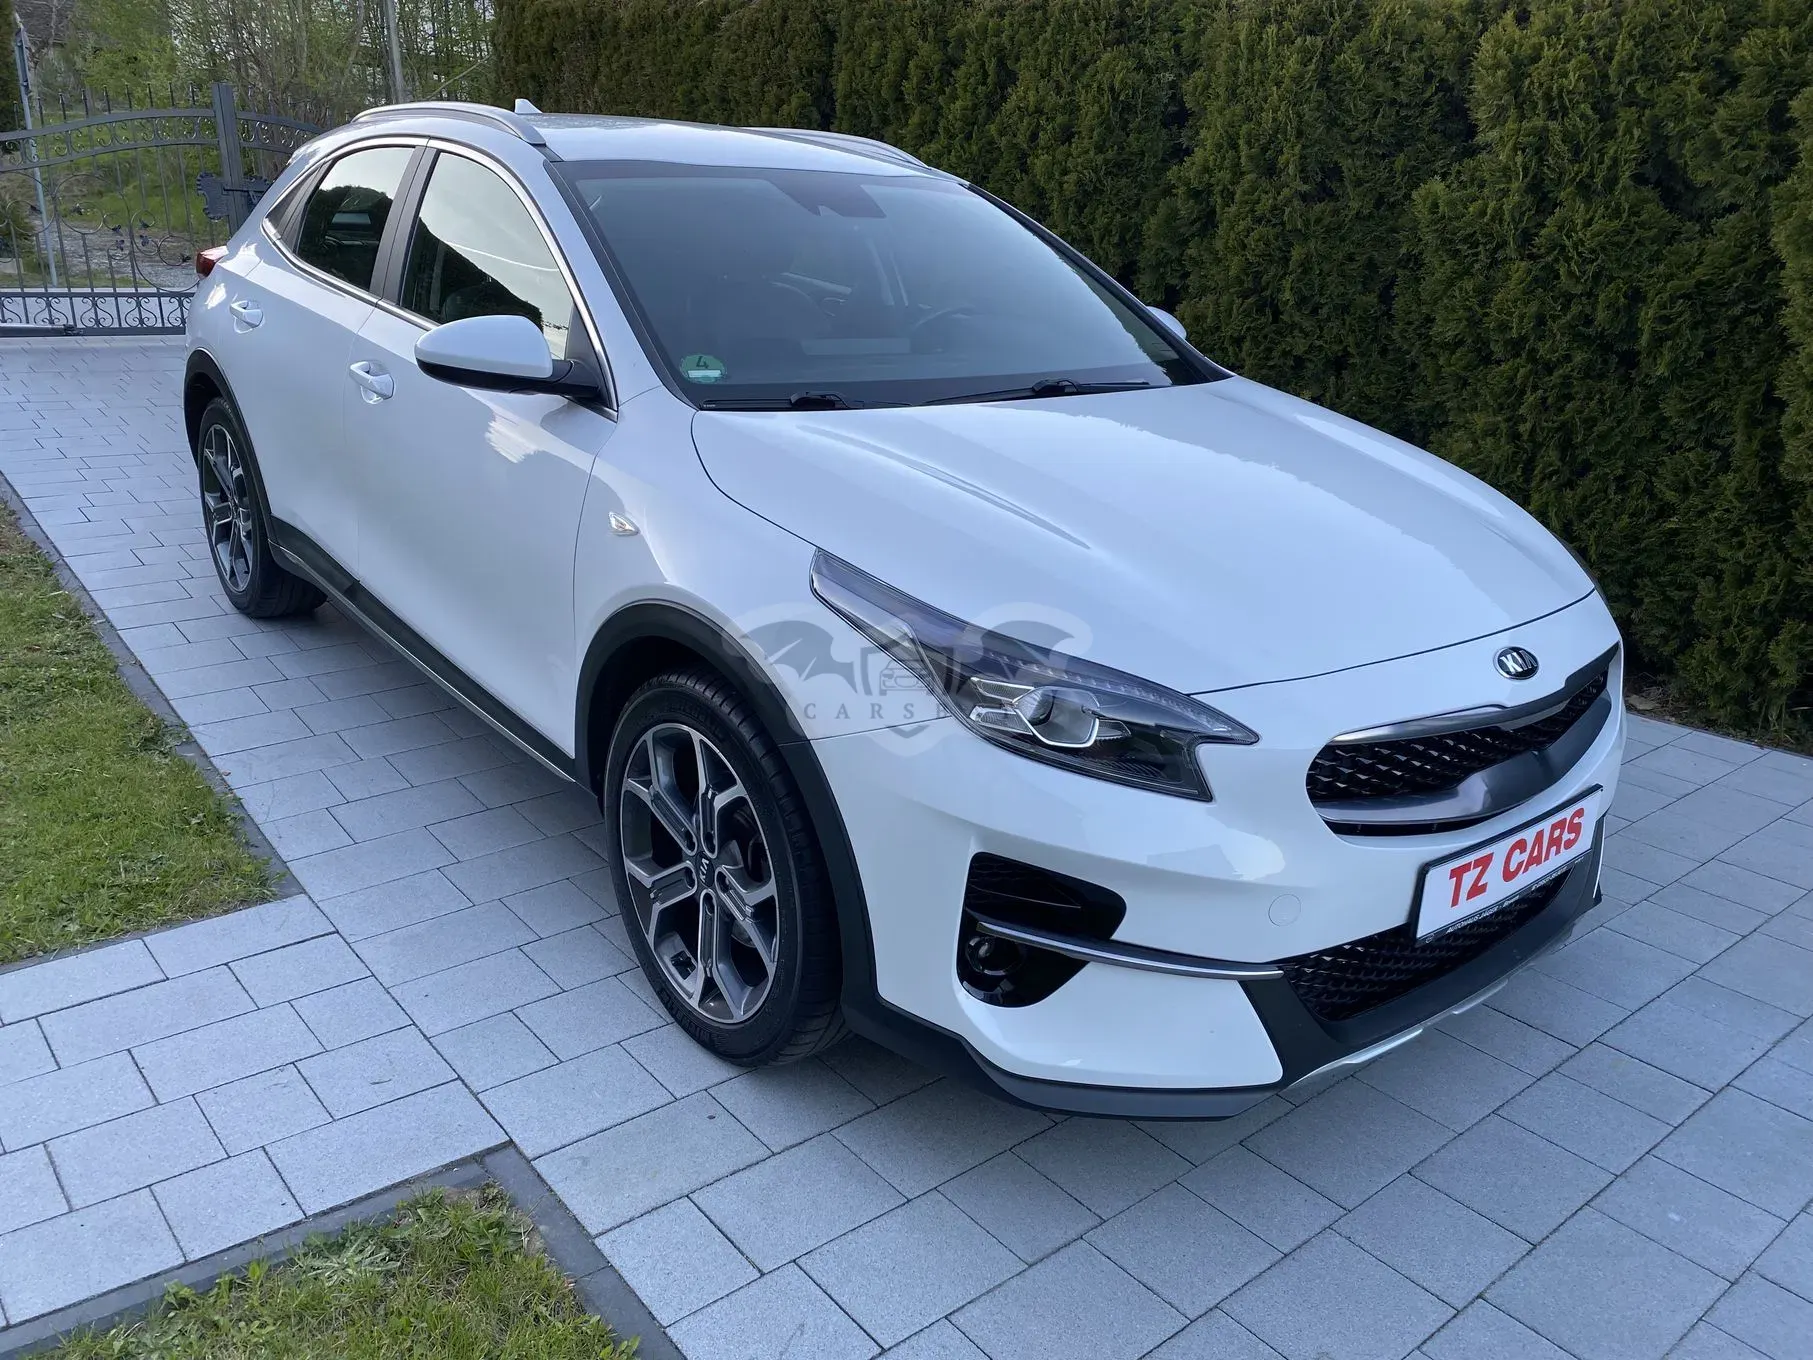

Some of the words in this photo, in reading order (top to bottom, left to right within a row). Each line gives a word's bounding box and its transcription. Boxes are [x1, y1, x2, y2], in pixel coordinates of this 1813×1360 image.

[696, 356, 709, 368] 4
[1449, 852, 1494, 908] TZ
[1502, 807, 1584, 883] CARS
